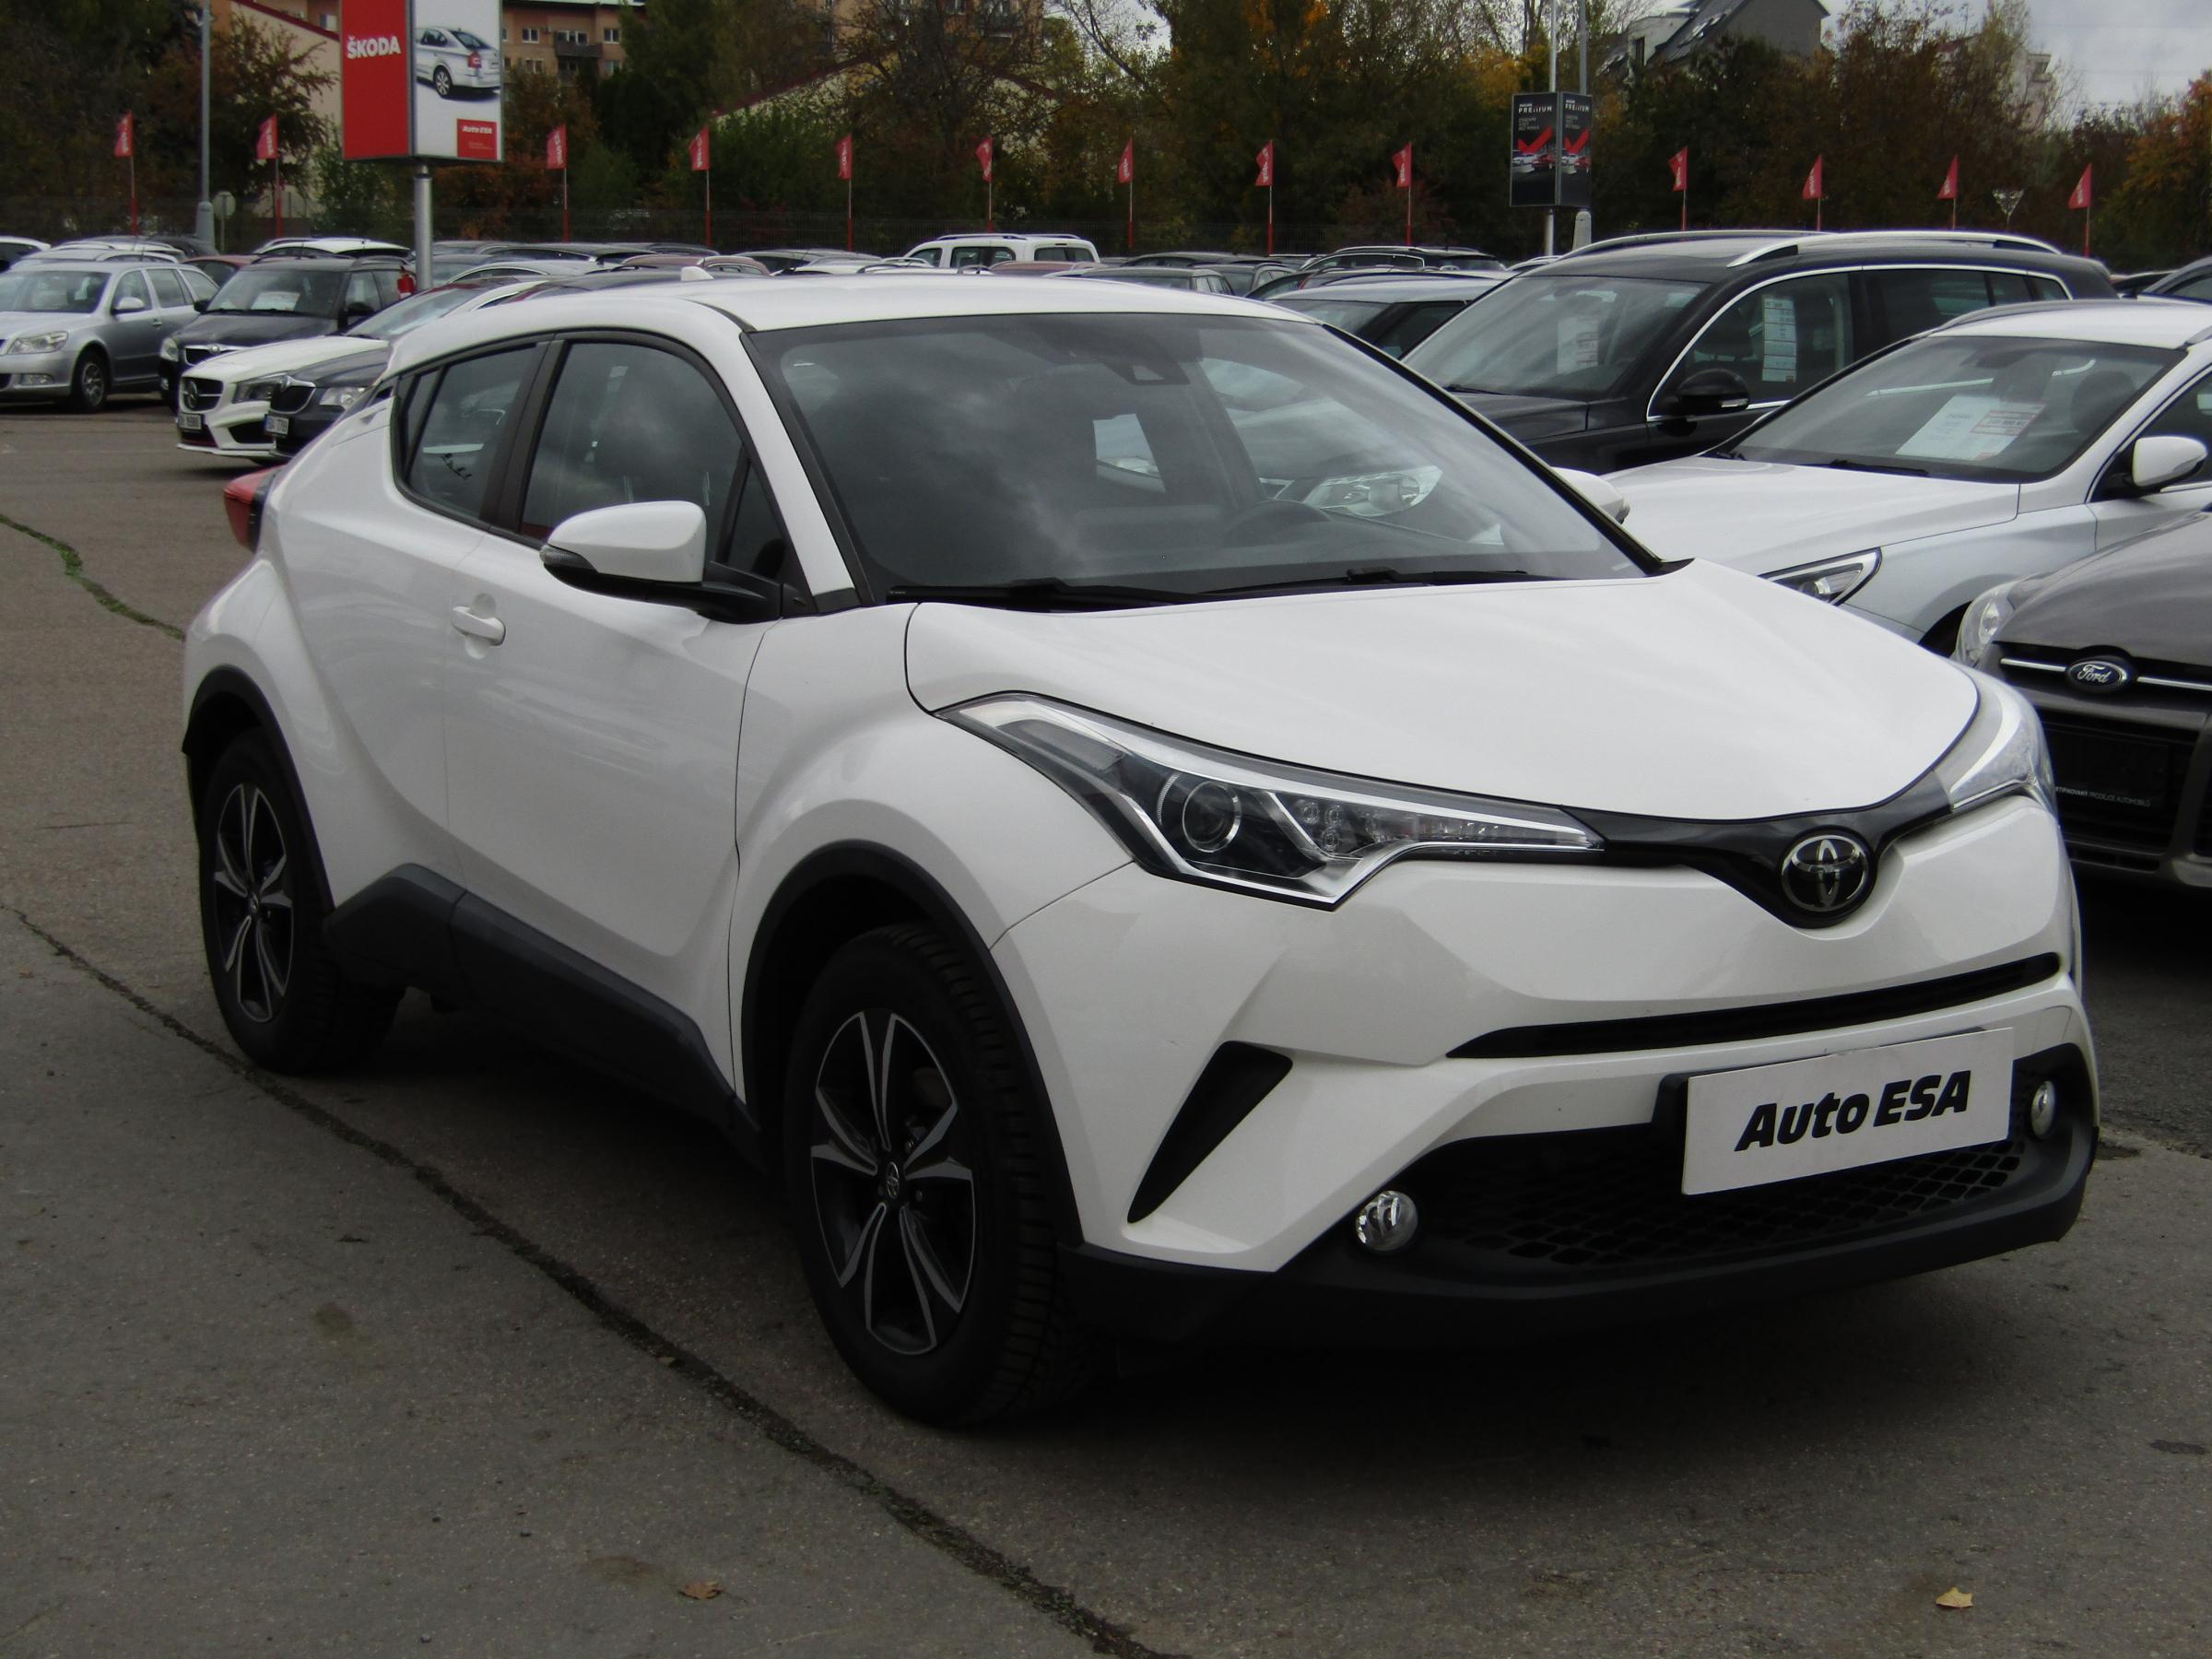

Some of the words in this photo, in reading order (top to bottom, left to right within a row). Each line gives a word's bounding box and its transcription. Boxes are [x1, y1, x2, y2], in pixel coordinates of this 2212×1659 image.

[347, 35, 402, 60] ŠKODA
[2077, 664, 2112, 683] Ford
[1734, 1091, 1871, 1152] Auto
[1873, 1069, 1971, 1127] ESA
